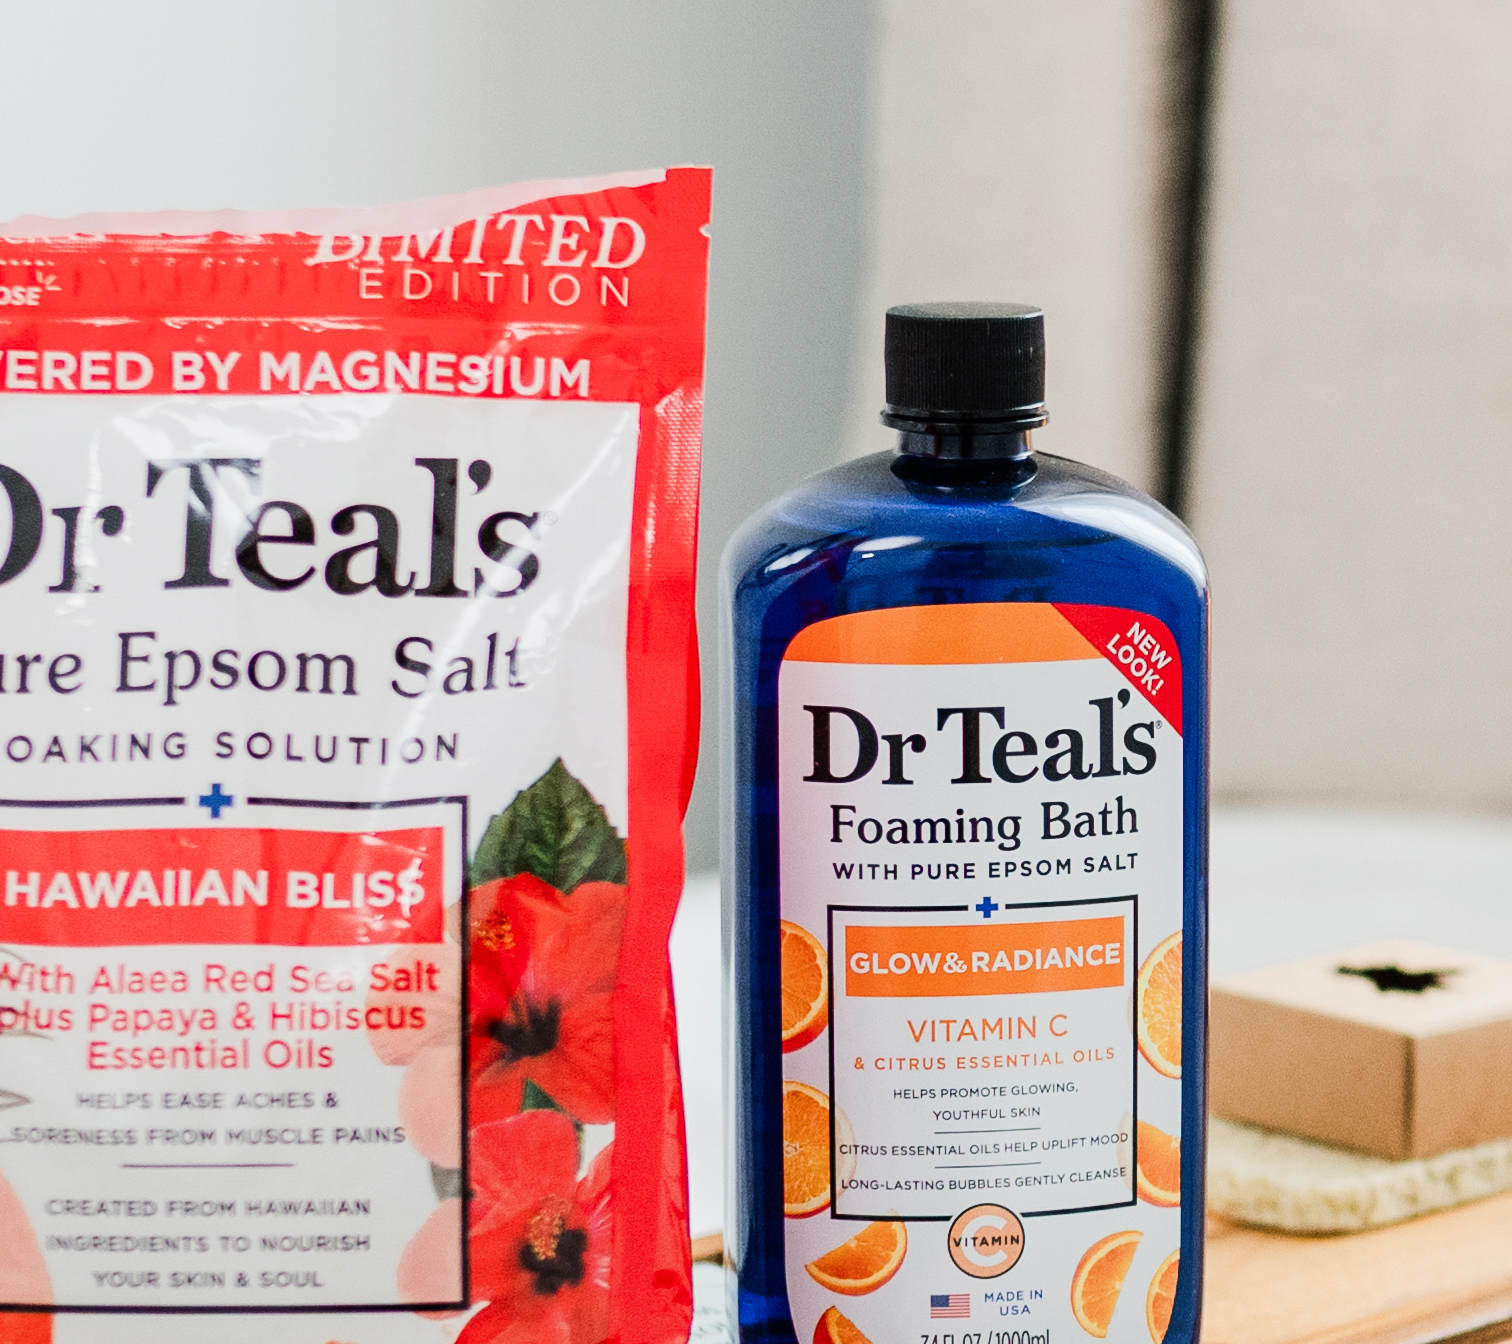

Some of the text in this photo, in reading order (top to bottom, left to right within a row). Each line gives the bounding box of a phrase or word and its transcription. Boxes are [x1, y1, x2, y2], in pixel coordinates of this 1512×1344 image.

[359, 267, 629, 307] EDITION
[171, 350, 241, 392] BY
[259, 350, 590, 398] MAGNESIUM
[146, 457, 542, 598] Teal's
[1127, 621, 1172, 669] NEW
[114, 630, 360, 706] Epsom
[390, 632, 527, 698] Salt
[1106, 633, 1164, 696] LOOK!
[214, 731, 460, 766] SOLUTION
[802, 688, 1158, 786] Dr Teal's
[830, 796, 1139, 851] Foaming Bath
[832, 852, 1139, 881] WITH PURE EPSOM SALT
[4, 869, 425, 910] HAWAIIAN BLISS
[88, 964, 189, 994] Alaea
[204, 964, 275, 994] Red
[289, 964, 355, 994] Sea
[369, 961, 441, 994] Salt
[88, 1003, 218, 1037] Papaya
[231, 1002, 255, 1031] &
[270, 1001, 426, 1031] Hibiscus
[907, 1014, 1068, 1043] VITAMIN C
[87, 1039, 334, 1071] Essential Oils
[854, 1047, 1116, 1070] & CITRUS ESSENTIAL OILS
[75, 1091, 339, 1110] HELPS EASE ACHES &
[893, 1082, 1079, 1099] HELPS PROMOTE GLOWING,
[933, 1107, 1041, 1121] YOUTHFUL SKIN
[11, 1126, 406, 1145] SORENESS FROM MUSCLE PAINS
[839, 1132, 1129, 1156] CITRUS ESSENTIAL OILS HELP UPLIFT MOOD
[841, 1167, 1126, 1191] LONG-LASTING BUBBLES GENTLY CLEANSE
[45, 1199, 371, 1217] CREATED FROM HAWAIIAN
[45, 1234, 371, 1252] INGREDIENTS TO NOURISH
[953, 1235, 1020, 1247] VITAMIN
[92, 1271, 324, 1288] YOUR SKIN & SOUL
[984, 1290, 1043, 1303] MADE IN
[1000, 1304, 1031, 1316] USA
